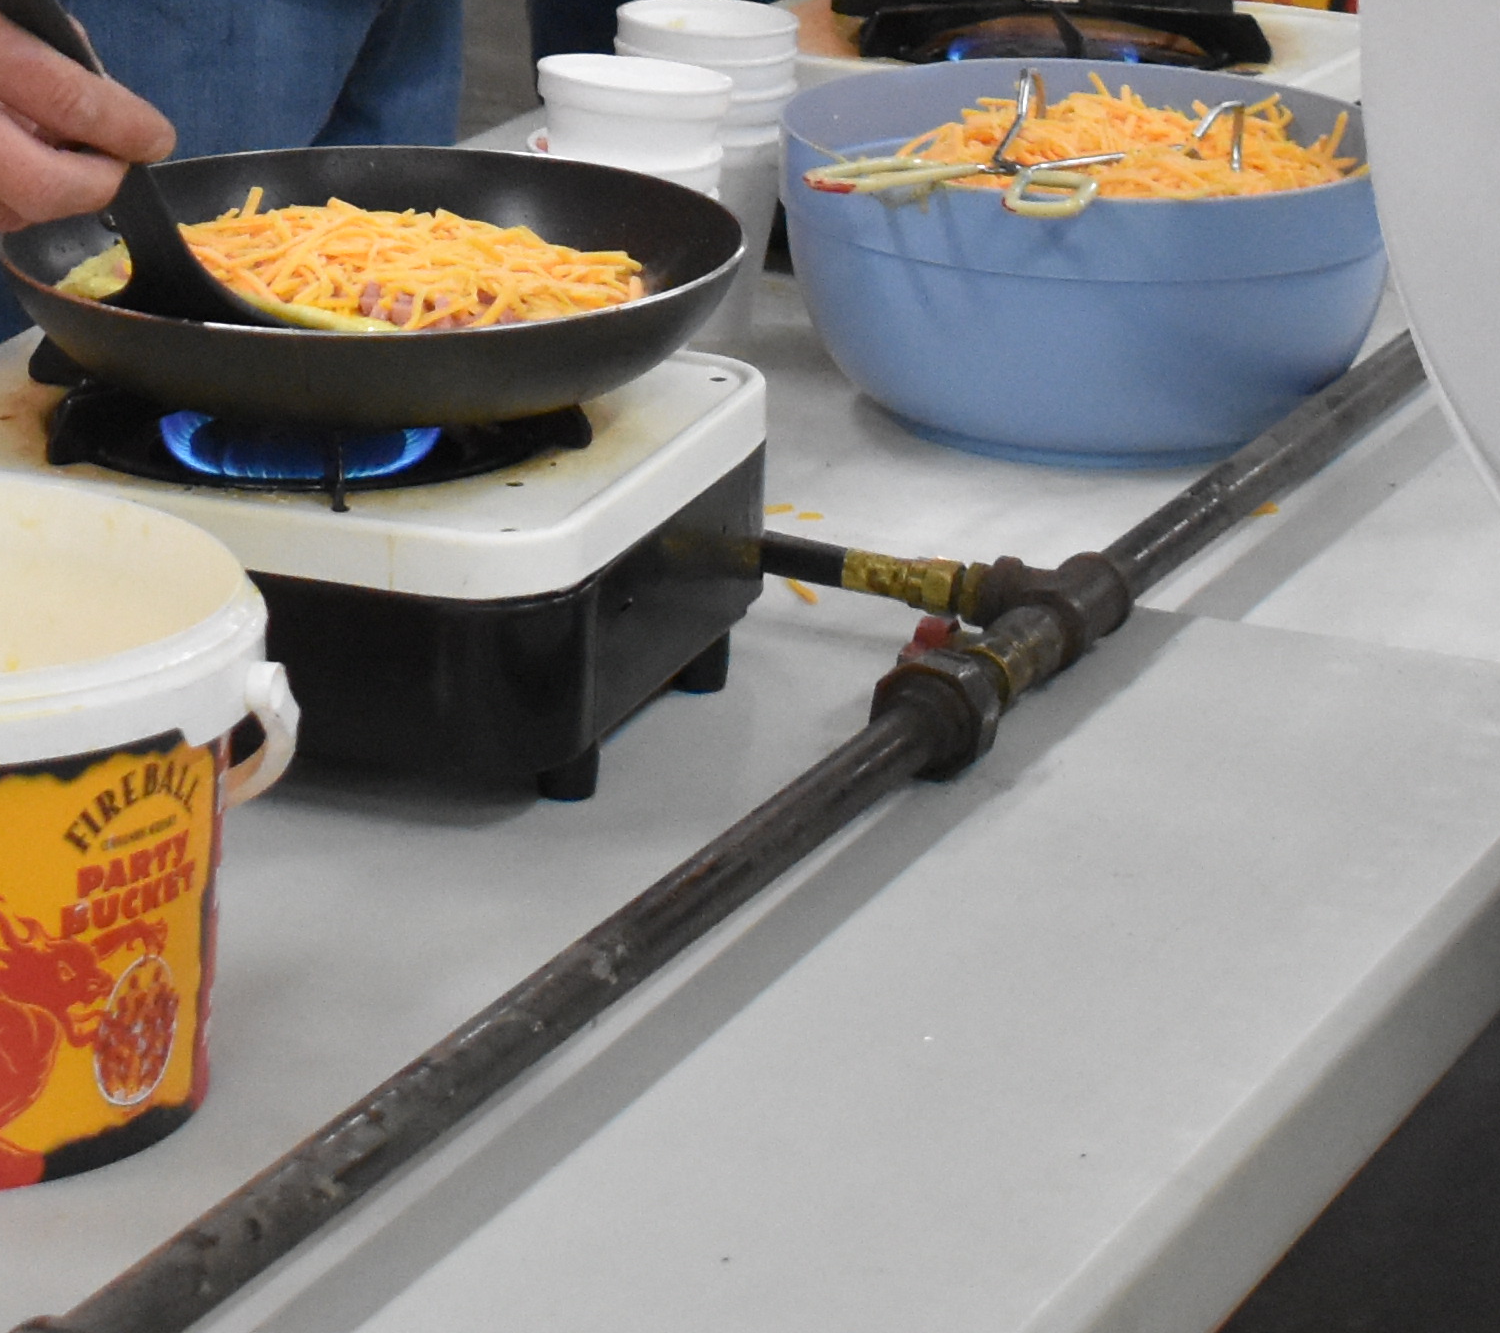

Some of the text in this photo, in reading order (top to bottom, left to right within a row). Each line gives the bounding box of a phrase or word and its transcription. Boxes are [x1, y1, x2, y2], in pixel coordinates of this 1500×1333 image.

[63, 761, 199, 853] FIREBALL
[61, 860, 196, 939] BUCKET
[77, 829, 190, 898] PARTY
